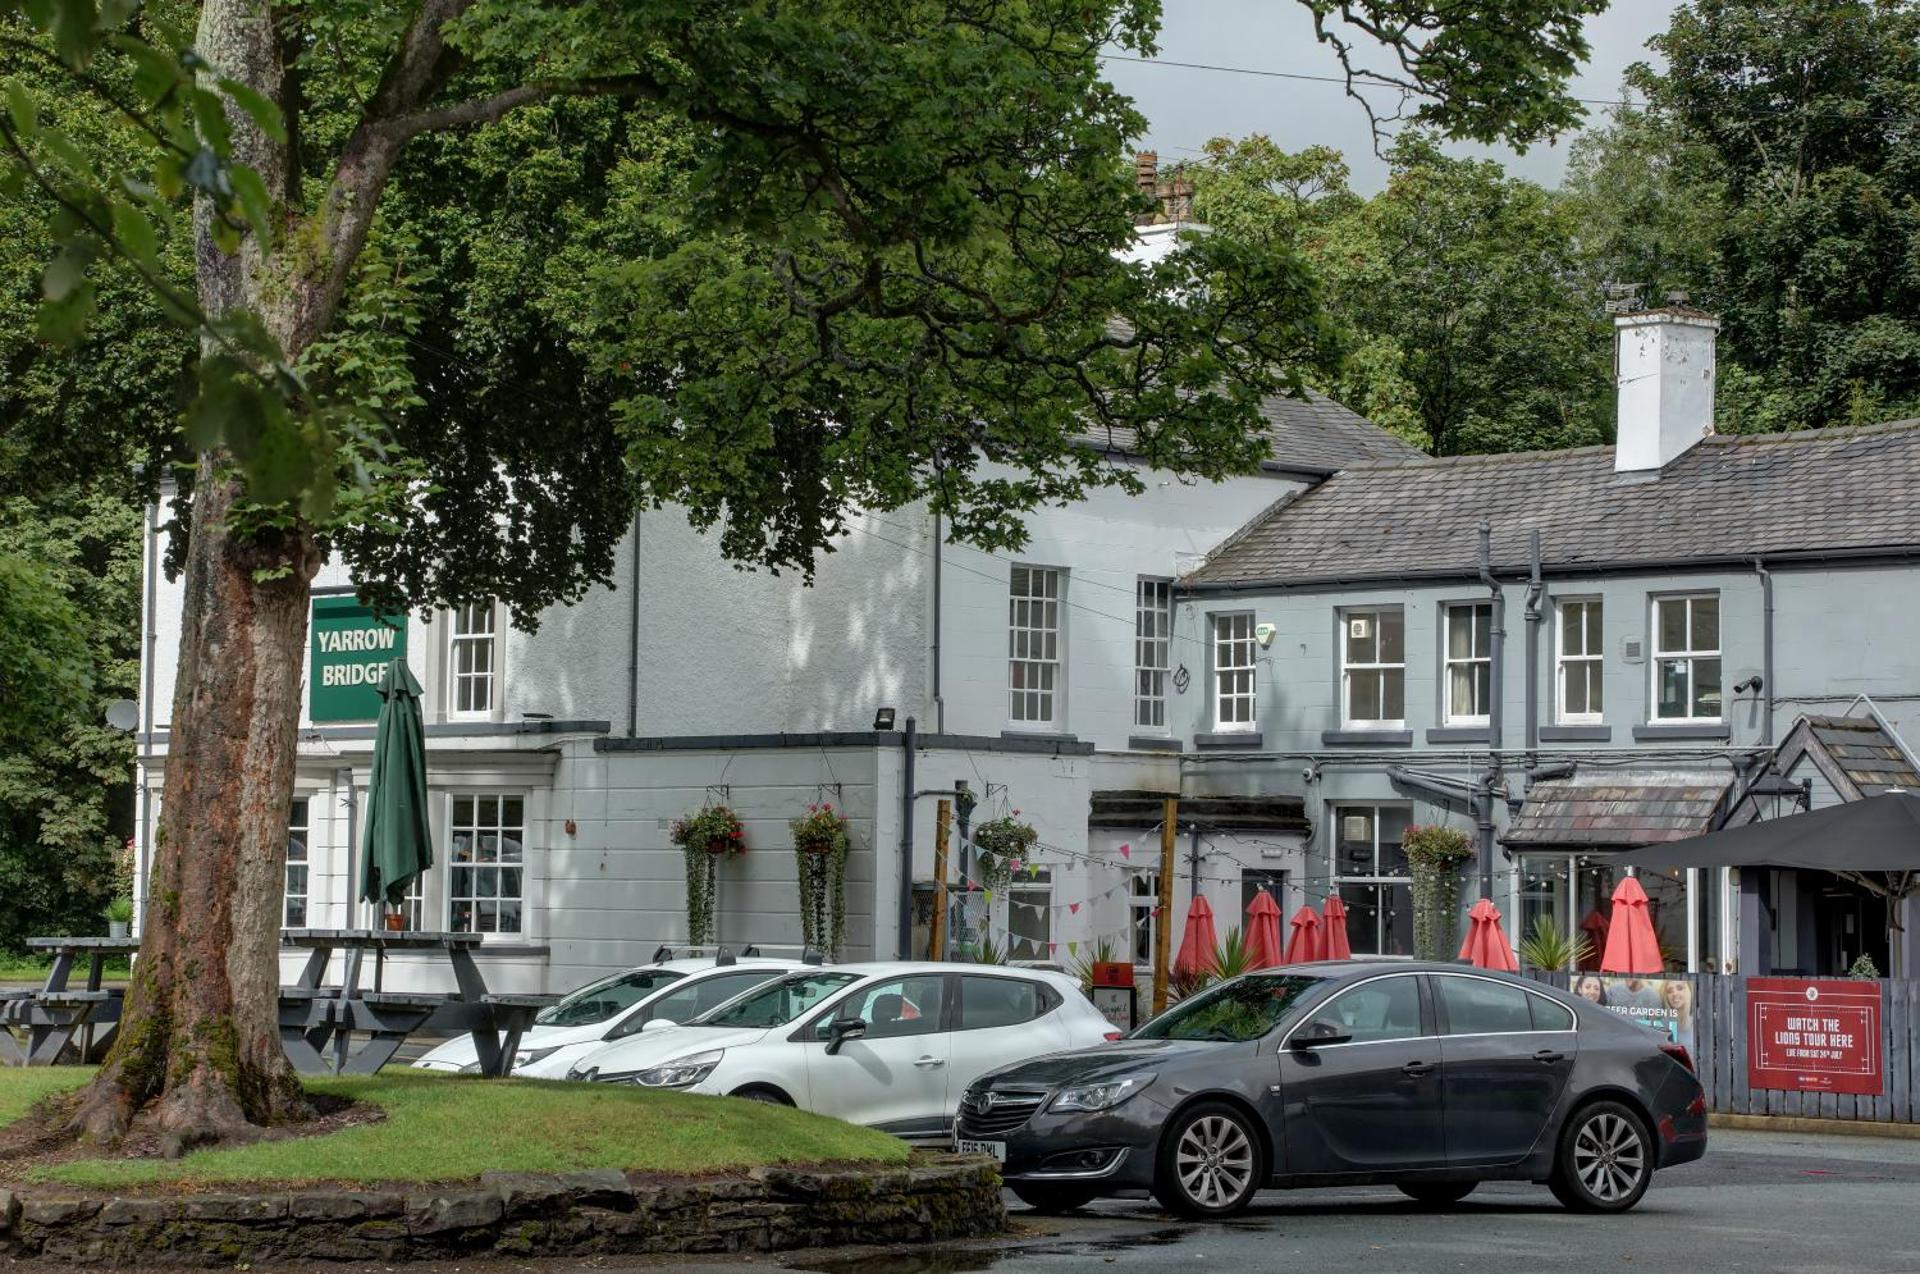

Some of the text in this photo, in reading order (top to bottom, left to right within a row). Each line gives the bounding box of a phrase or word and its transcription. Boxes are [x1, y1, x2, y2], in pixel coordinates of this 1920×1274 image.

[318, 628, 395, 653] YARROW
[1604, 1005, 1678, 1018] EER GARDEN IS
[1787, 1017, 1840, 1033] WATCH THE
[1775, 1031, 1854, 1048] LIONS TOUR HERE
